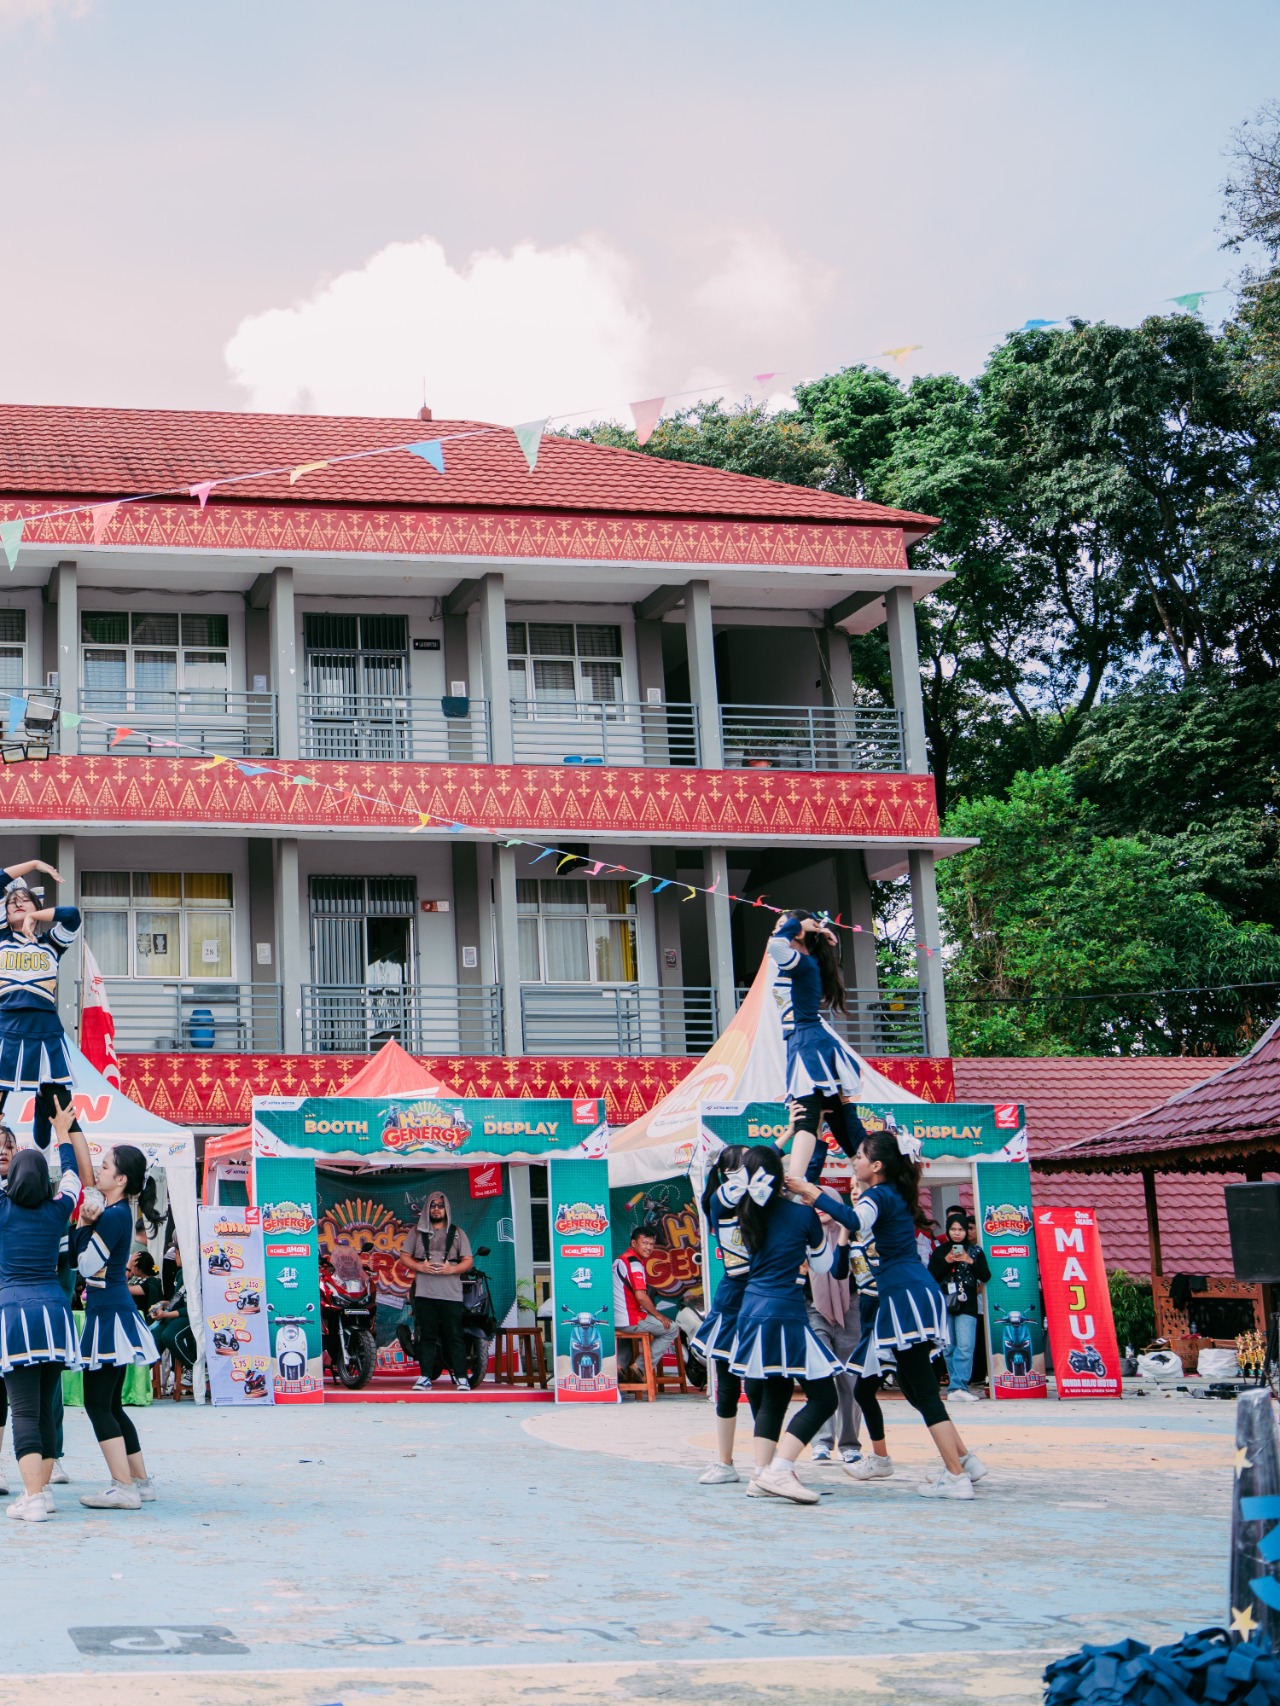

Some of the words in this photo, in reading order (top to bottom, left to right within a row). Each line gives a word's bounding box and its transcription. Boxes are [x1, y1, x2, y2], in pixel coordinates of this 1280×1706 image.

[400, 1112, 452, 1128] Honda
[305, 1121, 368, 1134] BOOTH
[484, 1122, 559, 1135] DISPLAY
[913, 1126, 983, 1138] DISPLAY
[383, 1126, 470, 1148] GENERGY
[272, 1209, 303, 1219] Honda
[565, 1210, 597, 1220] Honda
[992, 1211, 1023, 1221] Honda
[1074, 1211, 1089, 1219] One
[263, 1218, 314, 1232] GENERGY
[556, 1219, 608, 1232] GENERGY
[984, 1220, 1030, 1233] GENERGY
[1054, 1228, 1095, 1340] MAJU
